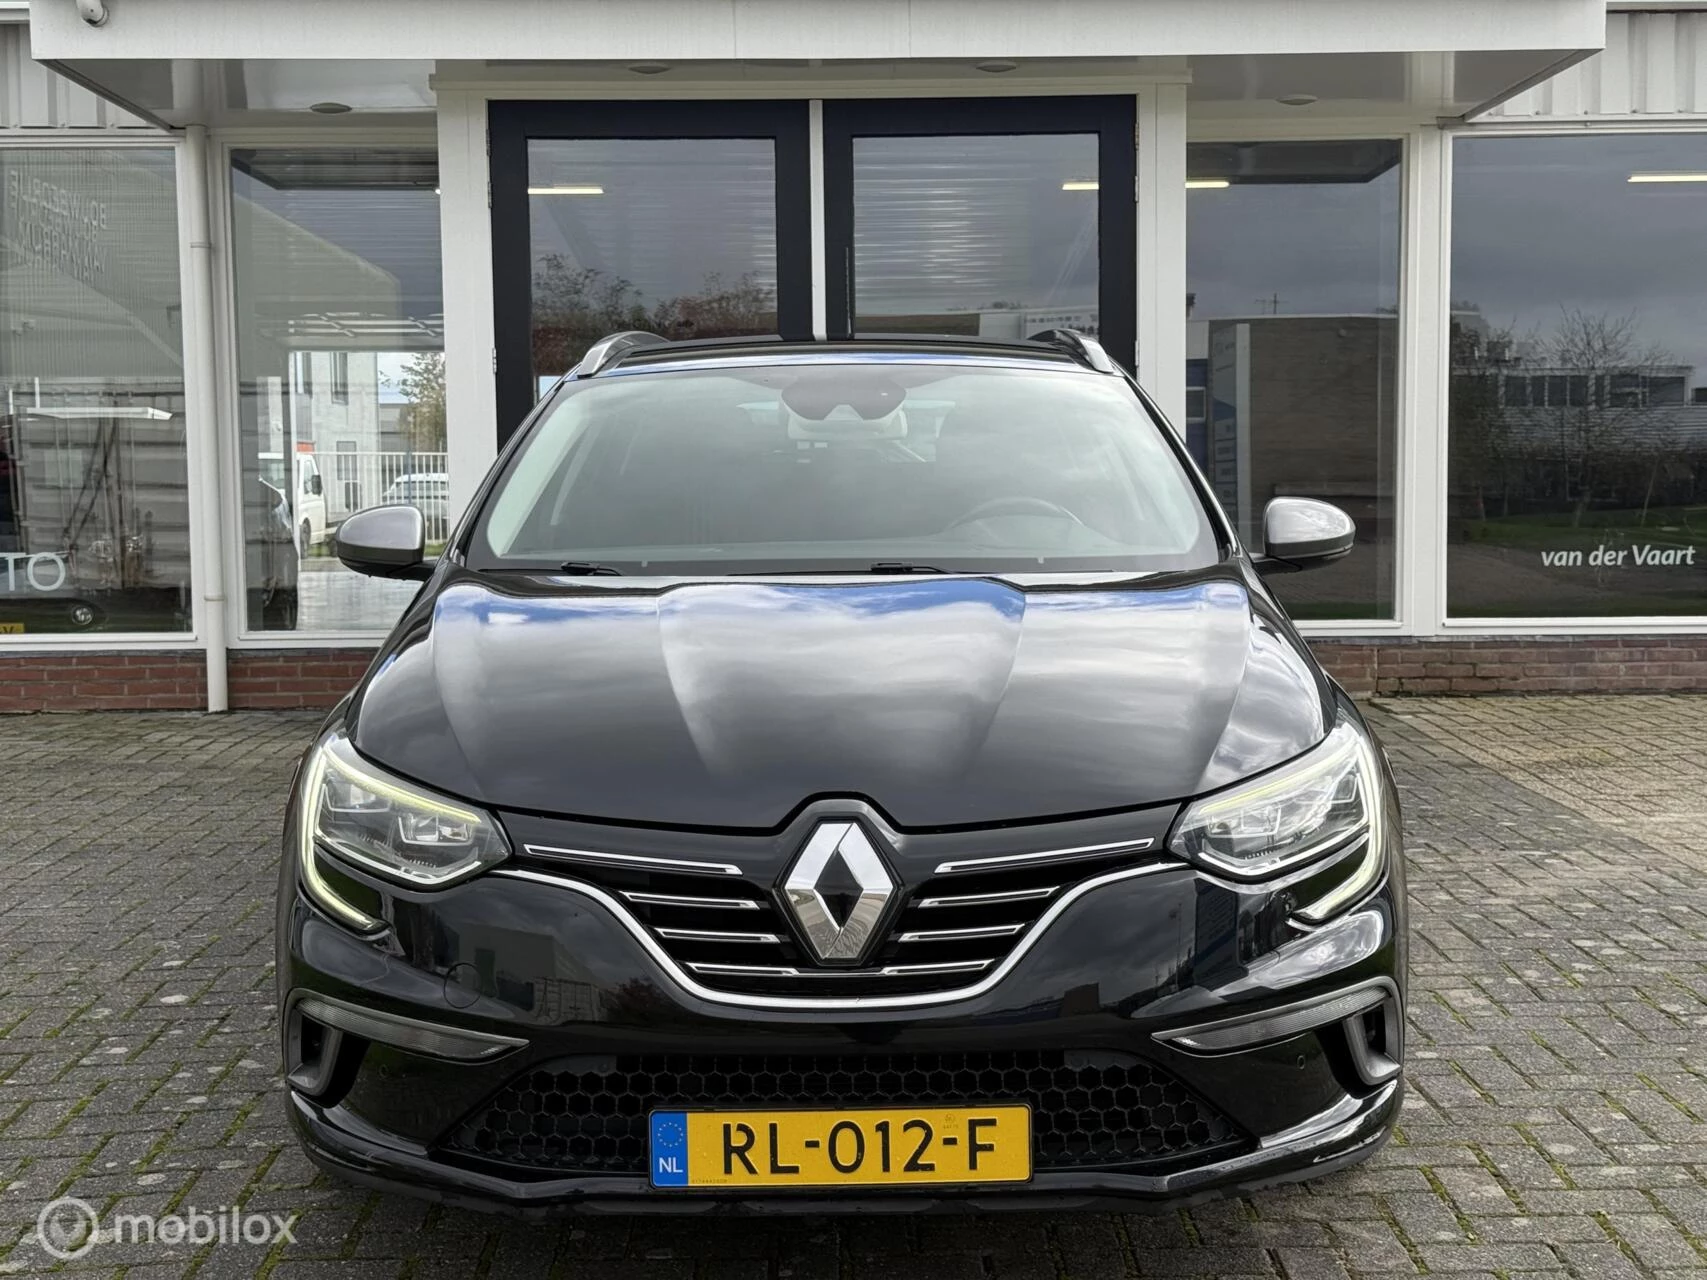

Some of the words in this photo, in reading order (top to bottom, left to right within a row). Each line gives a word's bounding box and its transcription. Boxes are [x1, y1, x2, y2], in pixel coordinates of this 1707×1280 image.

[1541, 550, 1583, 566] van
[1588, 544, 1628, 566] der
[1632, 544, 1696, 566] Vaart
[722, 1118, 997, 1175] RL-012-F
[659, 1157, 683, 1173] NL
